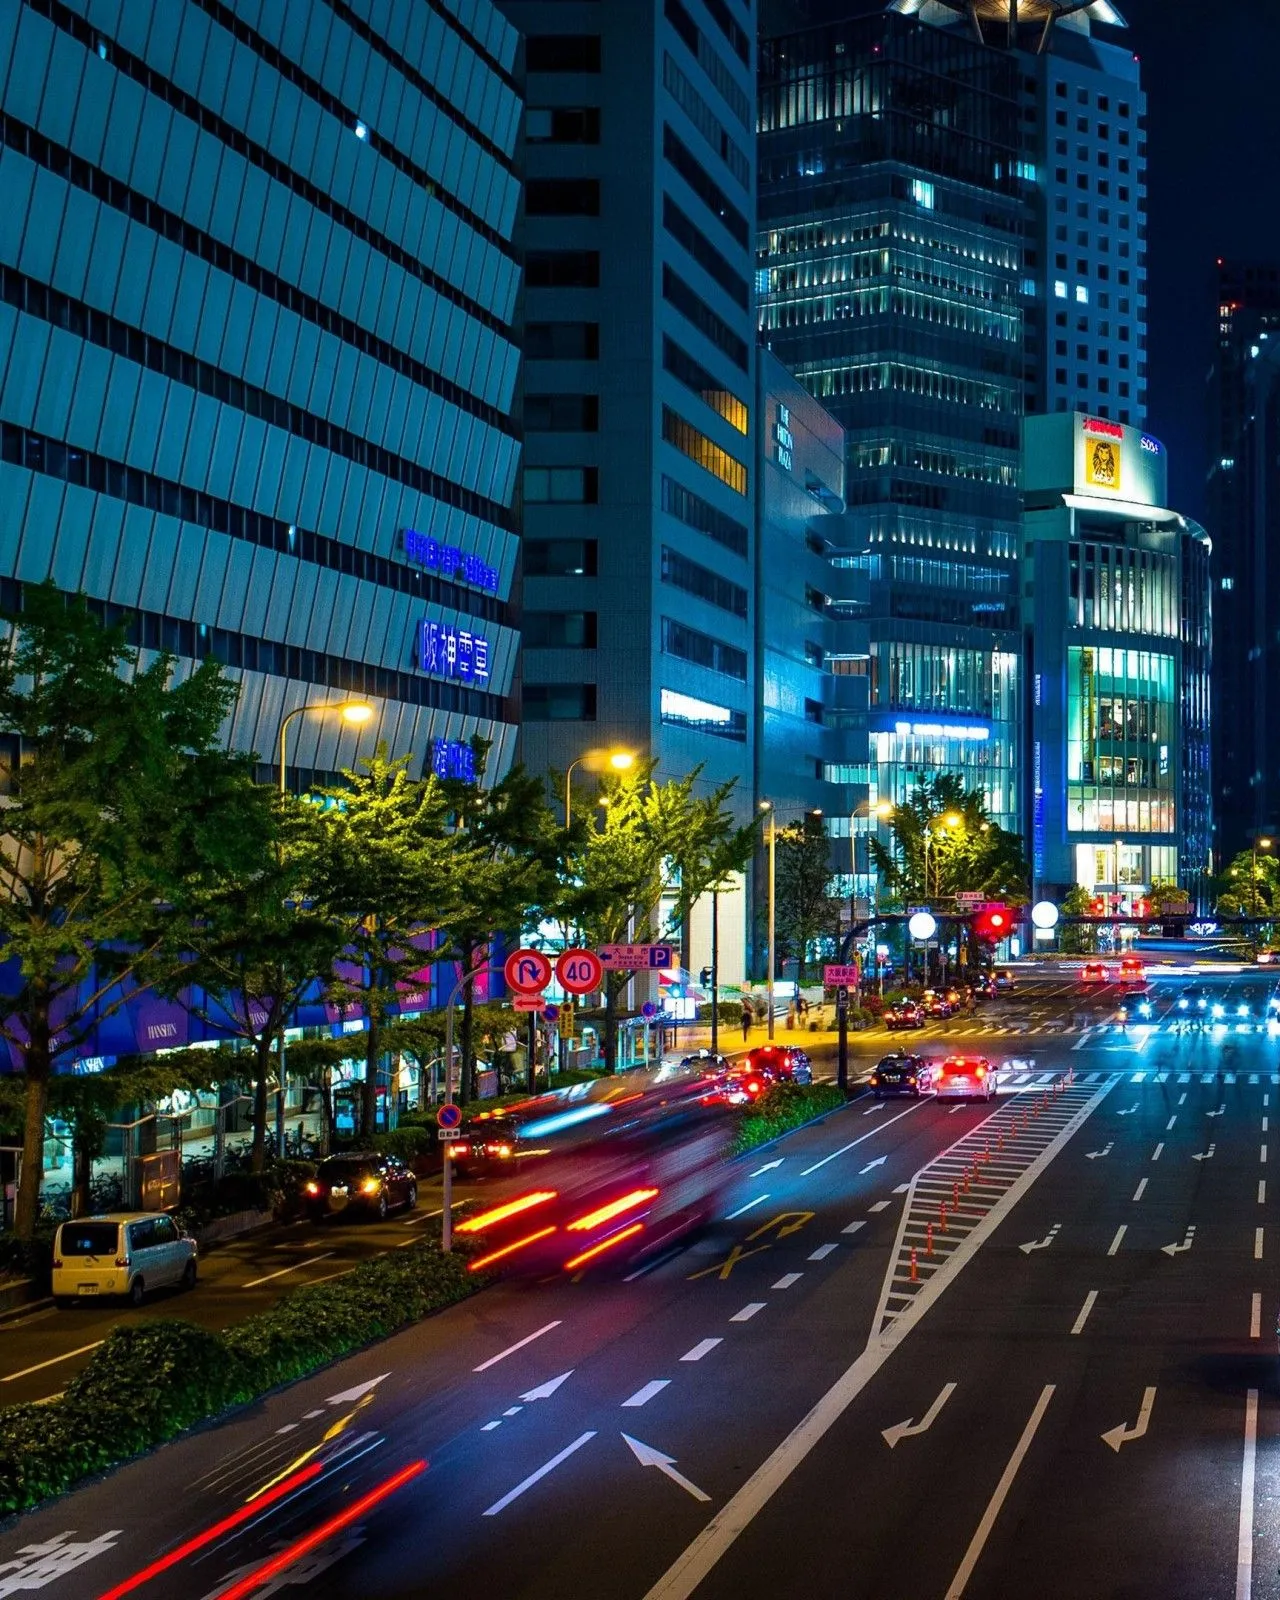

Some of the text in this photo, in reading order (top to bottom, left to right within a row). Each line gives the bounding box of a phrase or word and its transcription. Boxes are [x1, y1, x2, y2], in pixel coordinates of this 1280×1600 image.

[423, 621, 488, 684] 阪神電車
[655, 950, 665, 965] P
[567, 962, 591, 981] 40
[148, 1023, 177, 1039] HANSHIN
